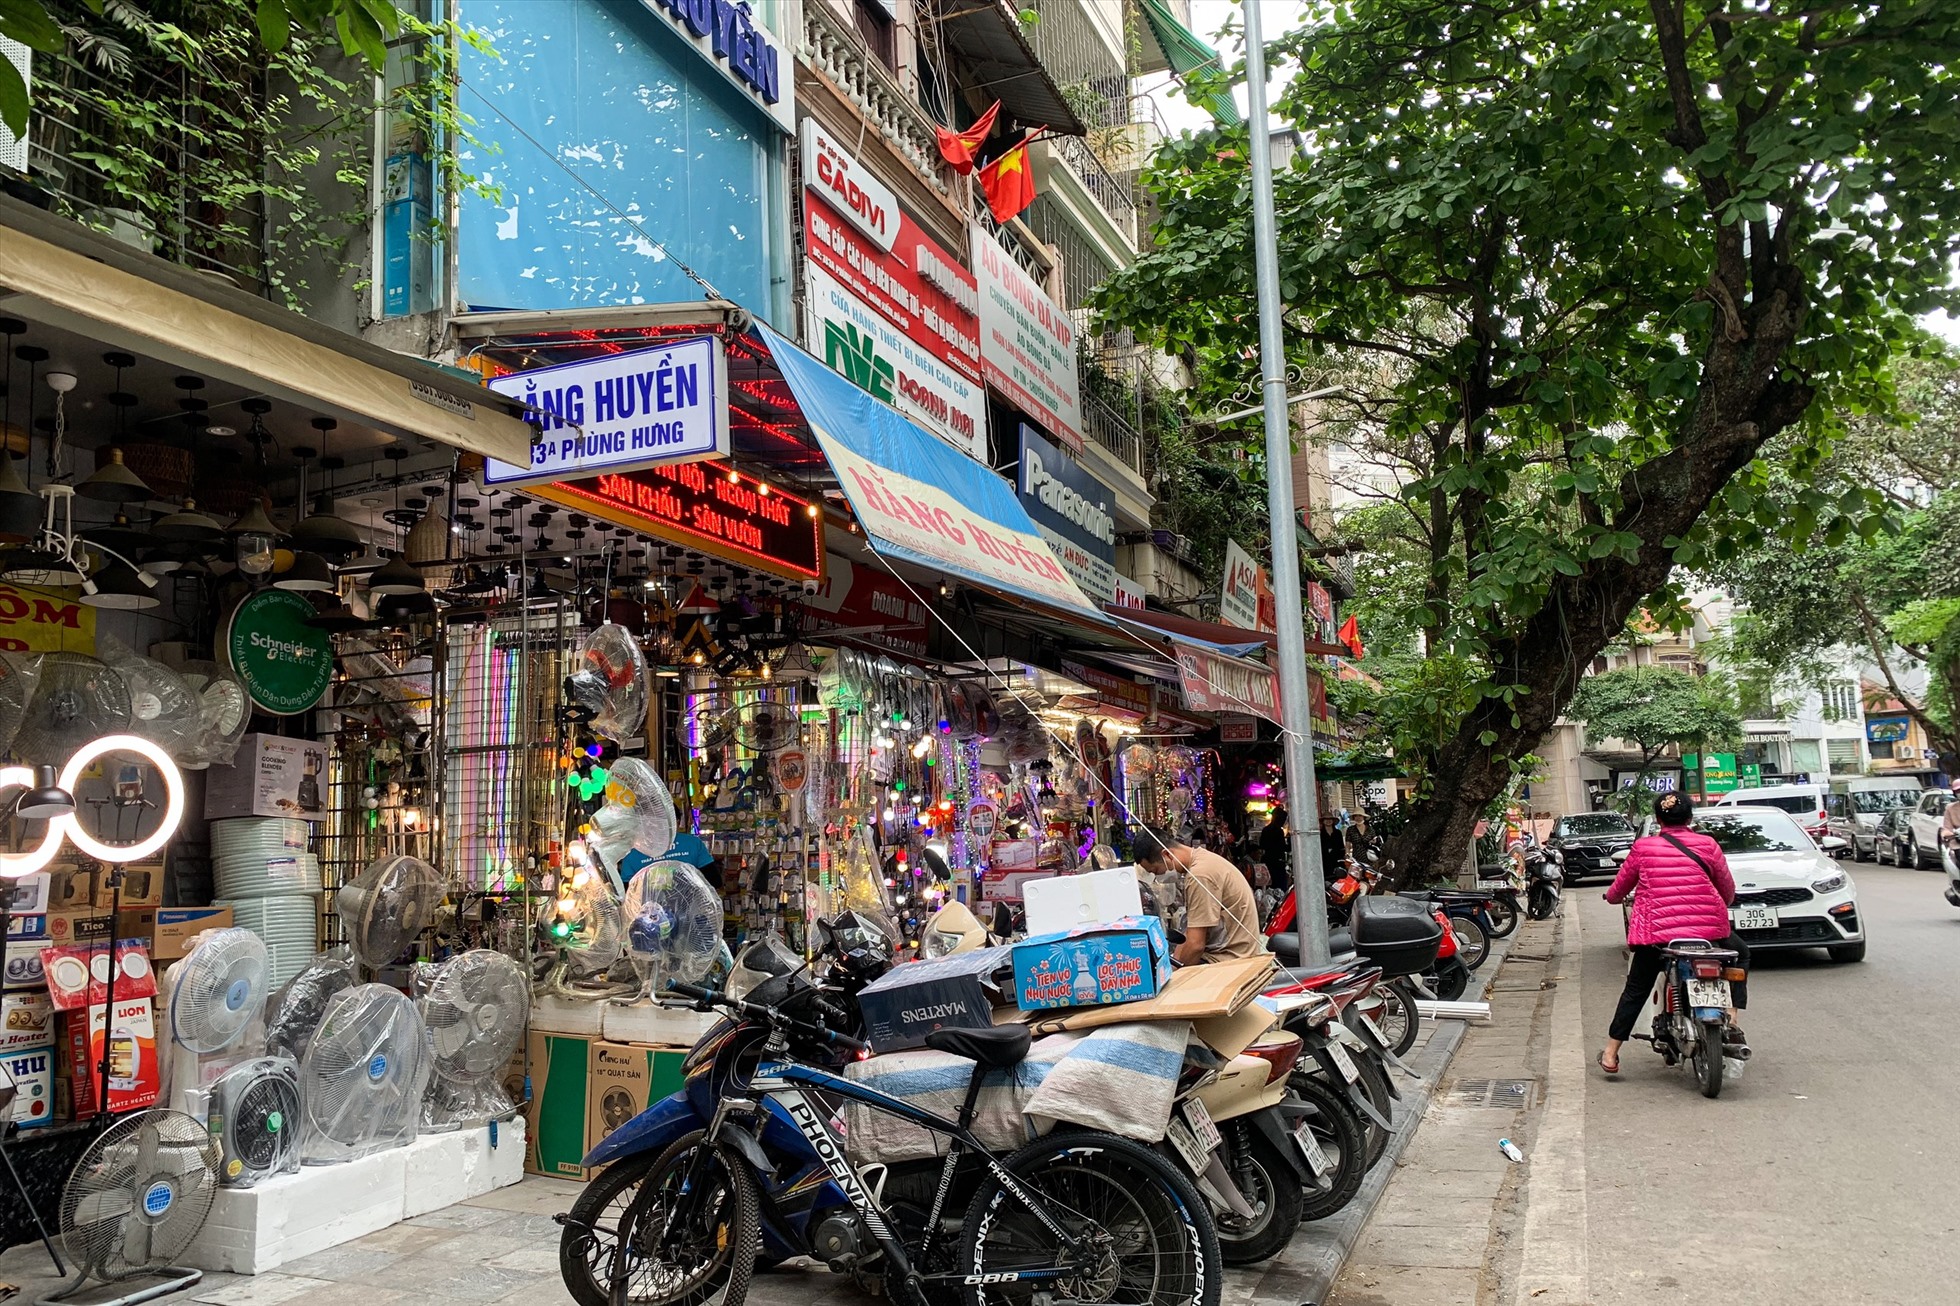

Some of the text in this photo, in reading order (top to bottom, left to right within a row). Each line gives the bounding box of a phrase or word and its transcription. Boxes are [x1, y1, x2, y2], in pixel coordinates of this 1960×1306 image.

[655, 0, 779, 105] UYỀN
[817, 152, 885, 236] CADIVI
[981, 238, 1071, 350] ÁO BÓNG ĐÁ.VIP
[989, 284, 1016, 321] CHUYÊN
[1016, 311, 1030, 333] BÁN
[1050, 342, 1063, 365] BÁN
[830, 290, 850, 316] CỬA
[852, 304, 877, 336] HÀNG
[879, 328, 902, 354] THIẾT
[904, 346, 913, 365] BỊ
[915, 354, 934, 377] ĐIỆN
[935, 368, 952, 389] CAO
[953, 381, 969, 399] CẤP
[1016, 329, 1052, 373] ÁO BÓNG ĐÁ
[512, 378, 583, 432] ẰNG
[595, 353, 698, 422] HUYỀN
[561, 428, 625, 460] PHÙNG
[631, 420, 684, 450] HƯNG
[599, 474, 634, 504] SÂN
[637, 486, 682, 522] KHẤU
[693, 506, 722, 532] SÂN
[1025, 448, 1115, 546] Panasonic
[848, 463, 967, 546] HẰNG
[961, 518, 1070, 586] HUYỀN
[1075, 551, 1089, 572] ĐỨC
[1237, 561, 1258, 595] ASIA
[871, 590, 926, 627] DOANH MAI
[250, 631, 317, 657] Schneider
[279, 651, 316, 667] Electric
[81, 922, 105, 931] Tico
[1739, 918, 1775, 929] 627.23
[1745, 909, 1765, 919] 30G
[1116, 957, 1142, 974] PHÚC
[117, 1005, 146, 1019] LION
[901, 1000, 967, 1024] MARTENS
[8, 1032, 49, 1045] Heater
[607, 1070, 626, 1079] QUẠT
[107, 1094, 156, 1110] UARTZ HEATER
[987, 1160, 1031, 1207] PHOENIX
